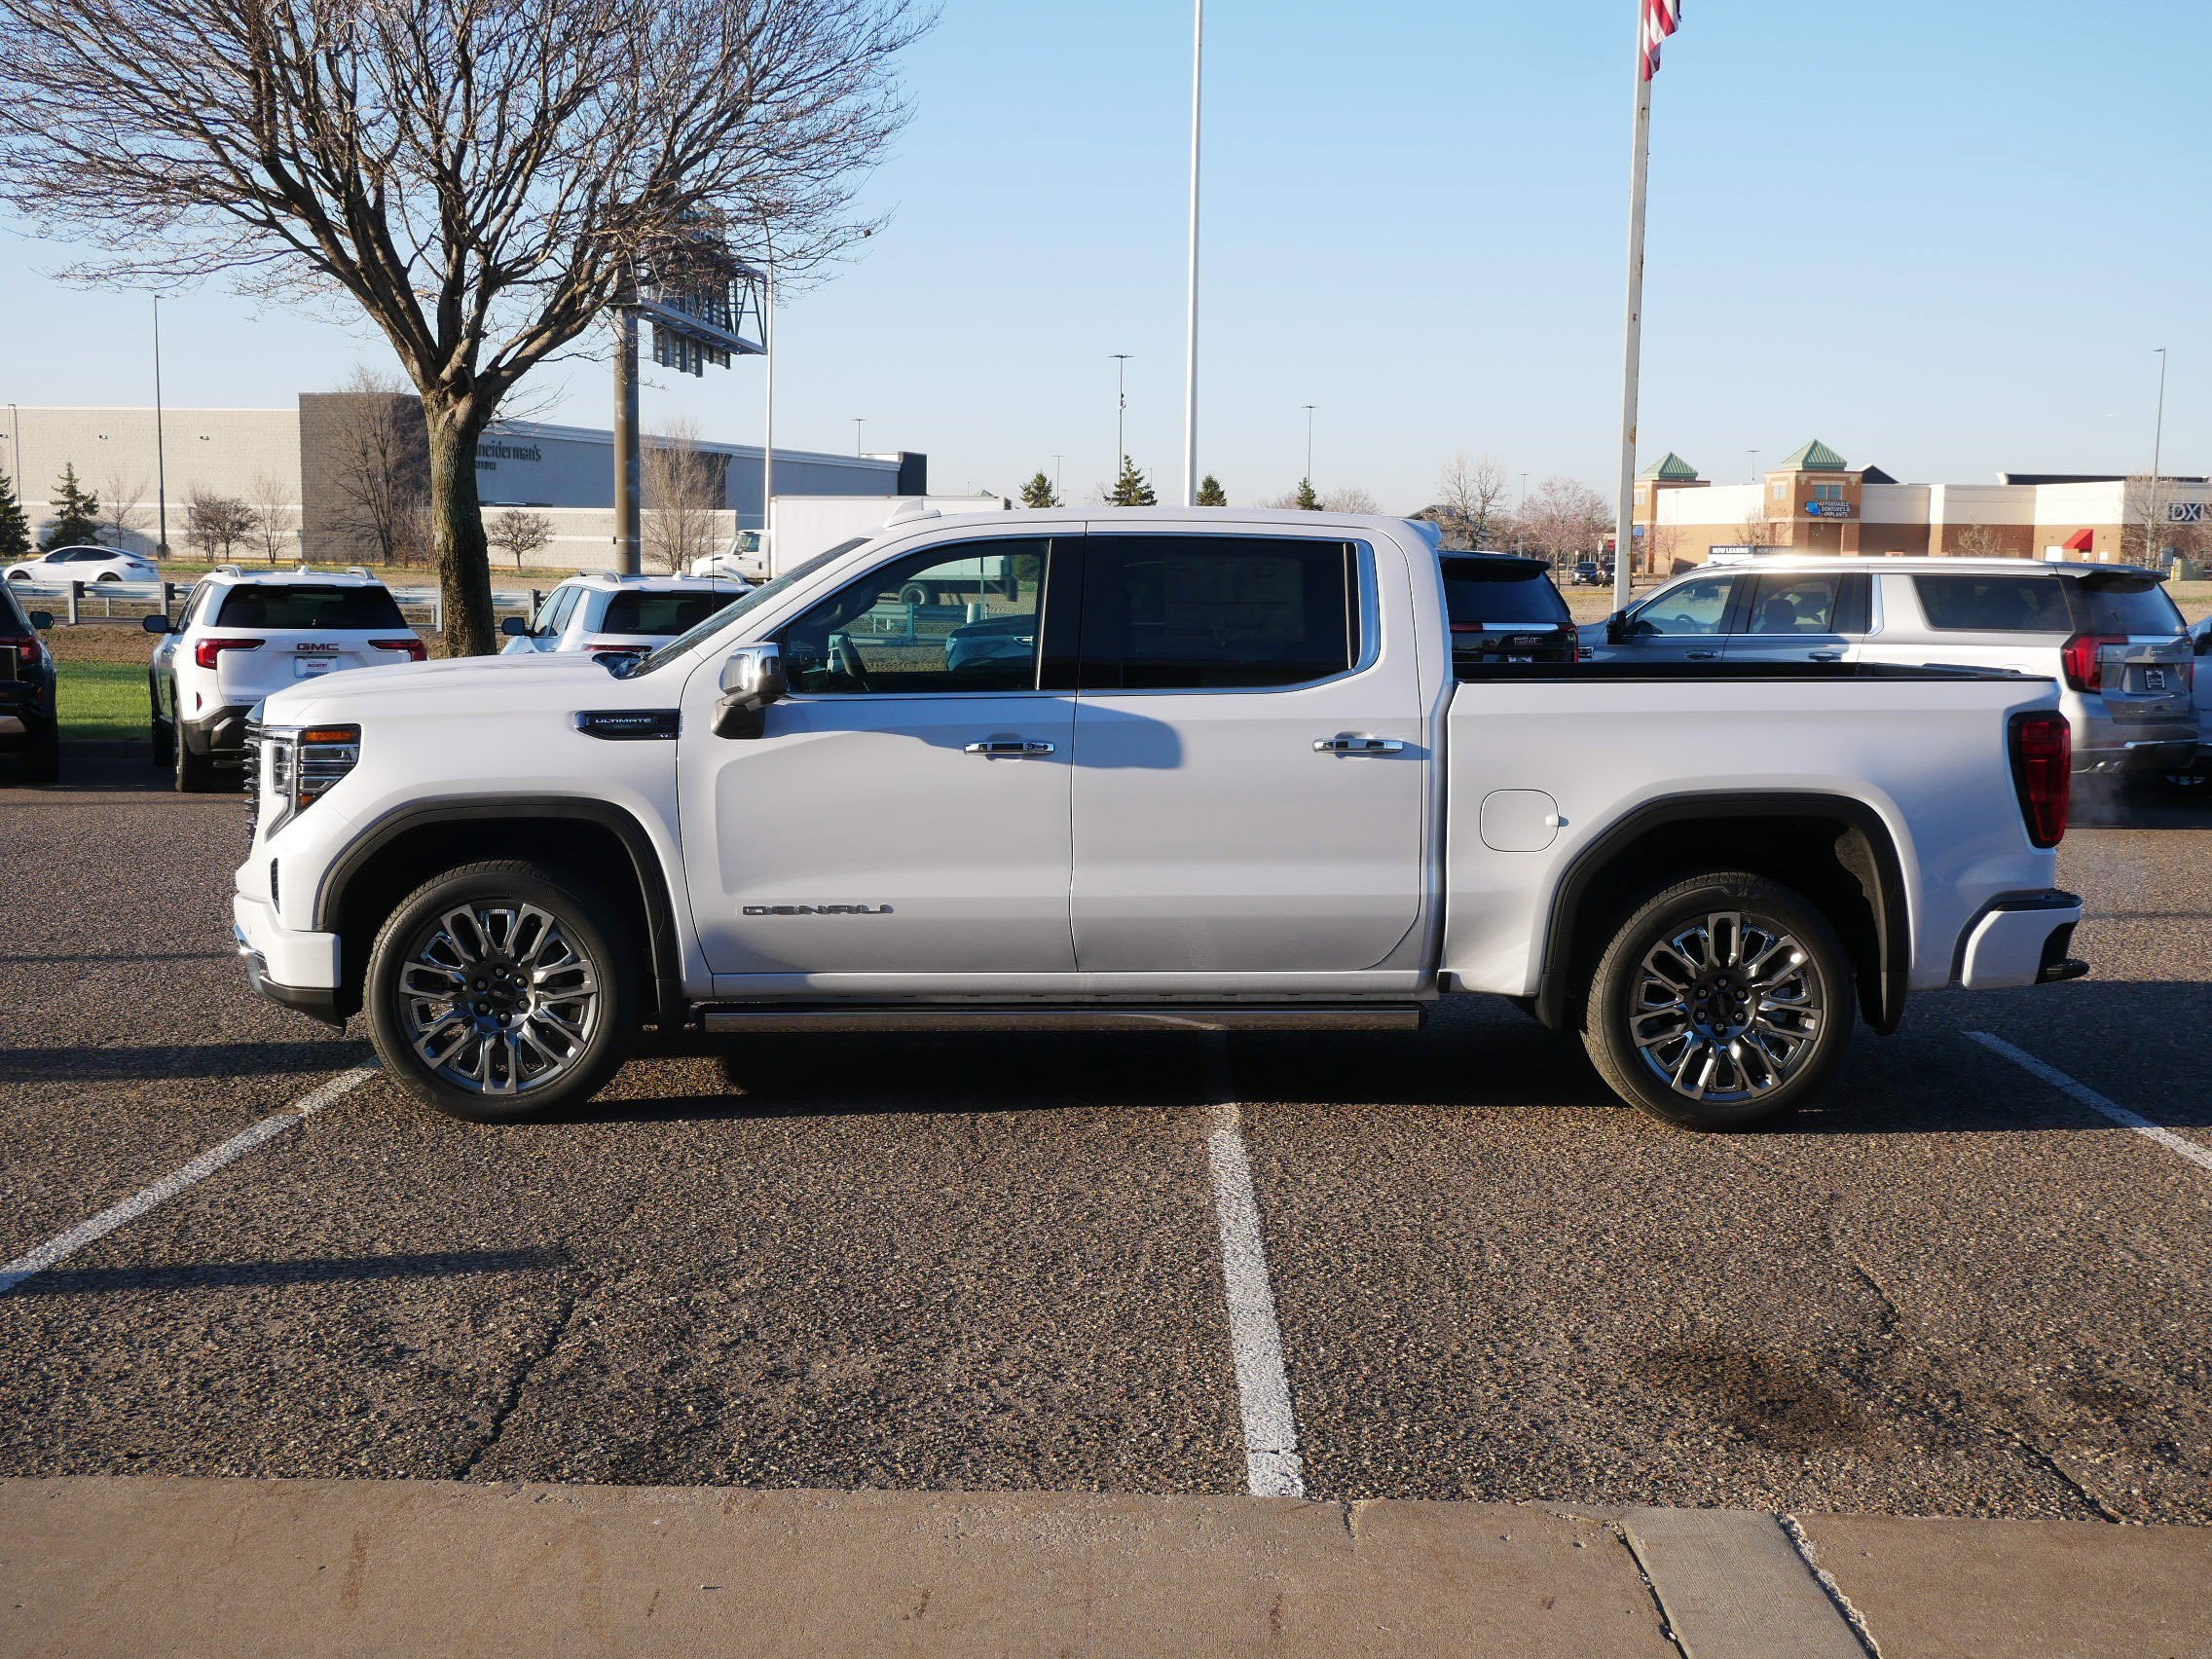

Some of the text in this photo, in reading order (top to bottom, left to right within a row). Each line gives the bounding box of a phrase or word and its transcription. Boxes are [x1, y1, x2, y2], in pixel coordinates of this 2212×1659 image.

[477, 441, 541, 461] neiderman's
[296, 643, 340, 651] GMC
[742, 904, 895, 915] DENALI
